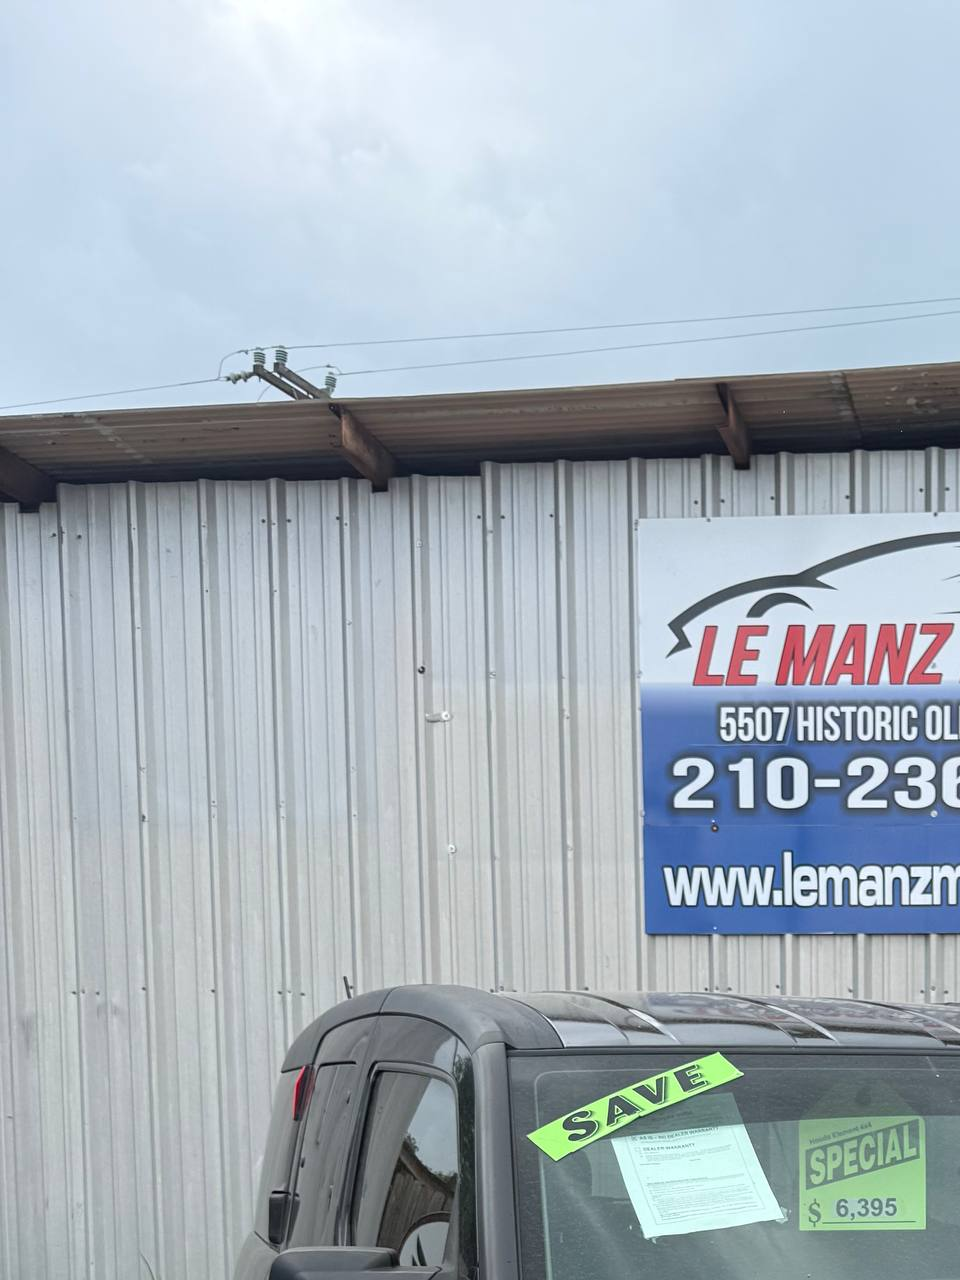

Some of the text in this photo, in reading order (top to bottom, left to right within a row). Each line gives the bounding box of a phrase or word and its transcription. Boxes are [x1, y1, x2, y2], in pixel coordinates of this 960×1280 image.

[693, 624, 769, 686] LE
[775, 622, 955, 686] MANZ
[719, 705, 790, 743] 5507
[798, 704, 918, 742] HISTORIC
[561, 1064, 709, 1144] SAVE
[810, 1125, 917, 1185] SPECIAL
[808, 1198, 897, 1227] $ 6,395
